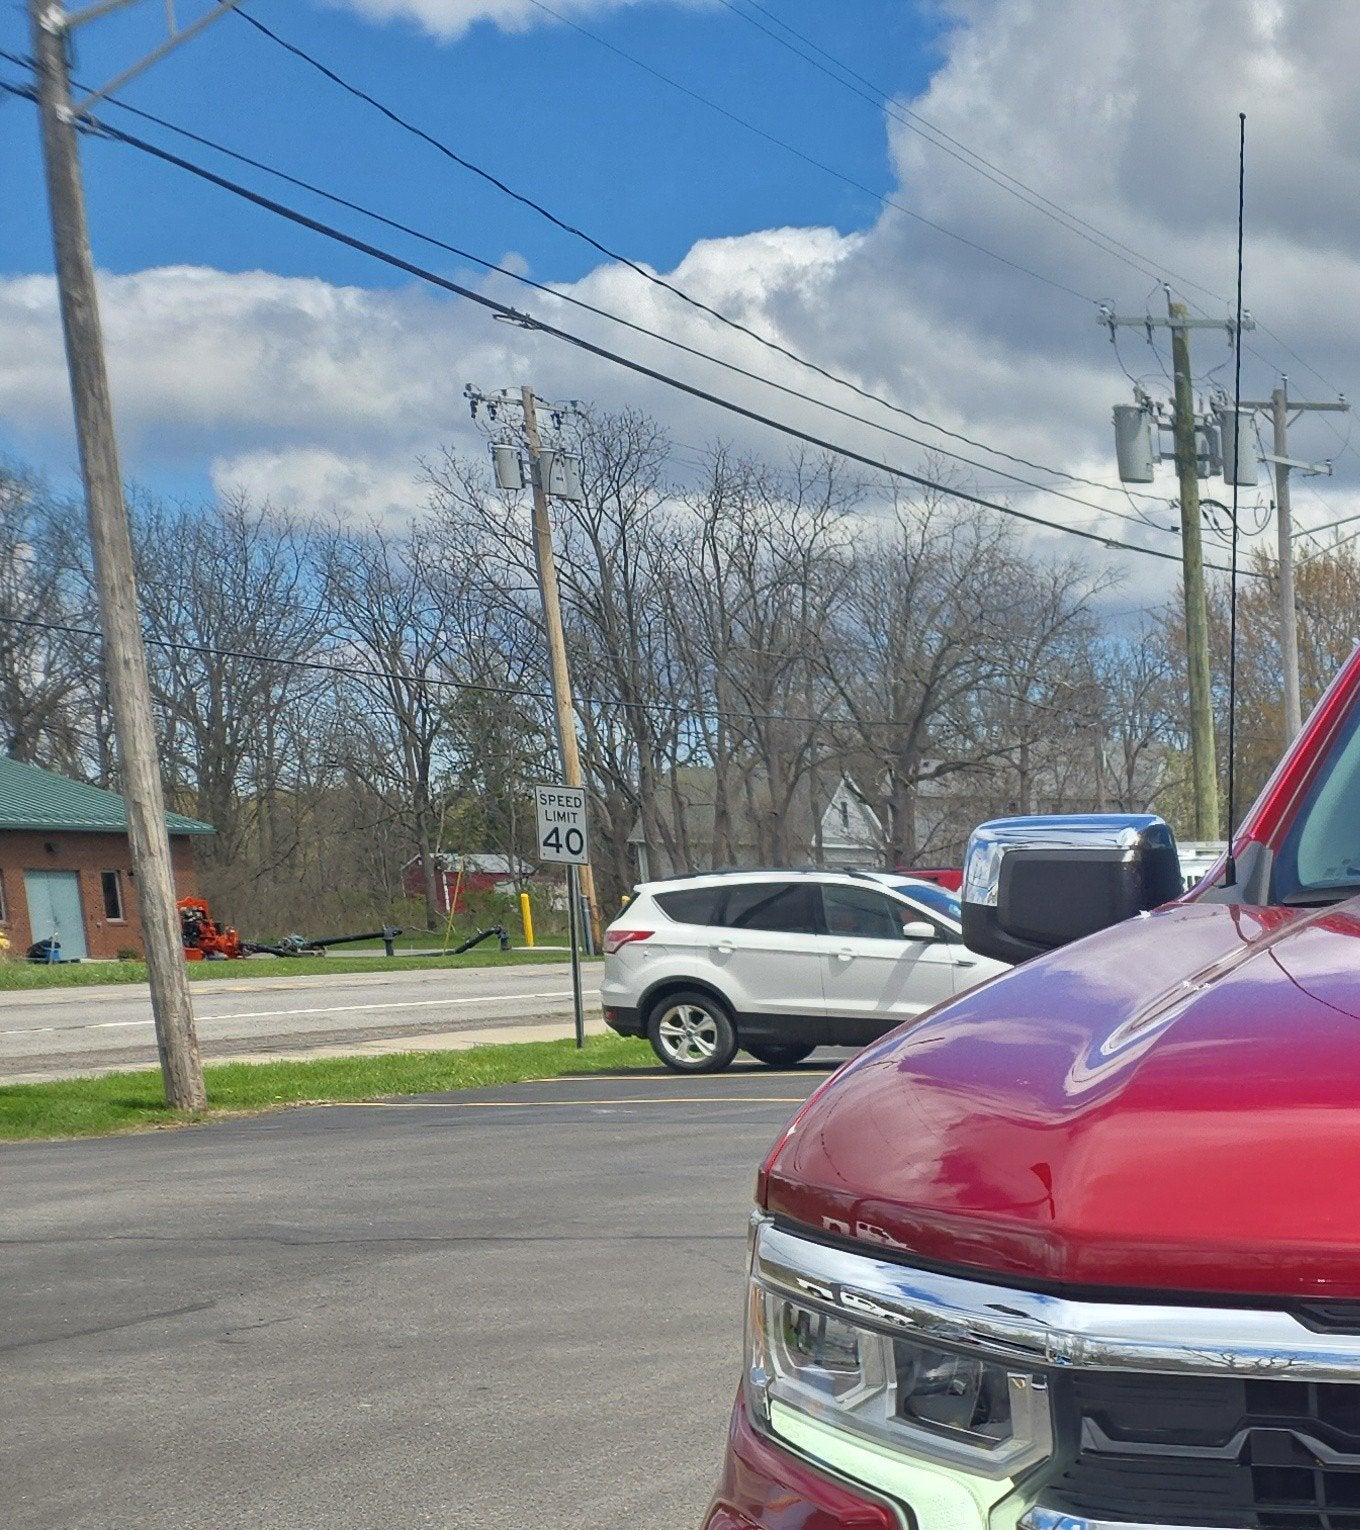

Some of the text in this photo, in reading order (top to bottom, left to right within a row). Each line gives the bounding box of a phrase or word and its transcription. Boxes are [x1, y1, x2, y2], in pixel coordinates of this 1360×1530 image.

[540, 794, 582, 808] SPEED
[545, 810, 578, 823] LIMIT
[542, 827, 584, 855] 40
